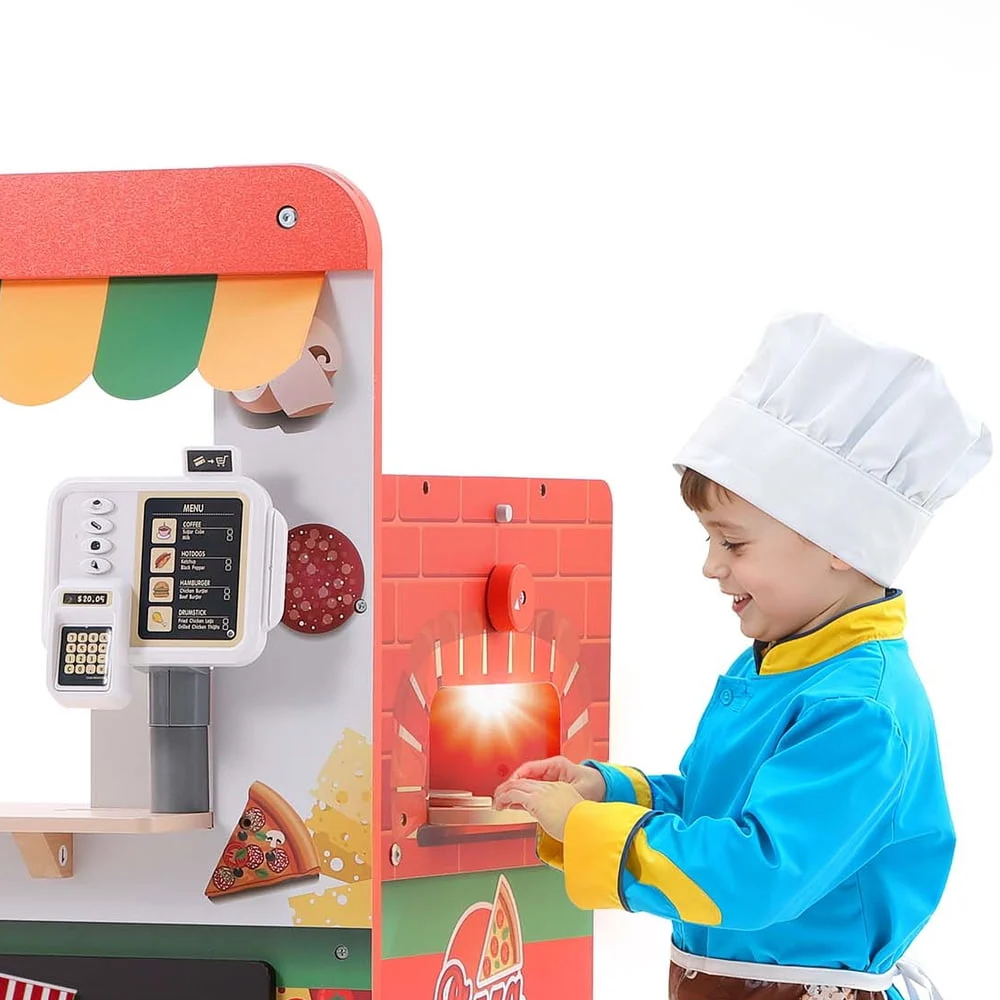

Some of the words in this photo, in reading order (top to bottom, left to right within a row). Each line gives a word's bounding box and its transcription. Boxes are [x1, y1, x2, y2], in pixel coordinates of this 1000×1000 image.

[183, 503, 204, 513] MENU
[182, 520, 202, 528] COFFEE
[181, 550, 206, 558] HOTDOGS
